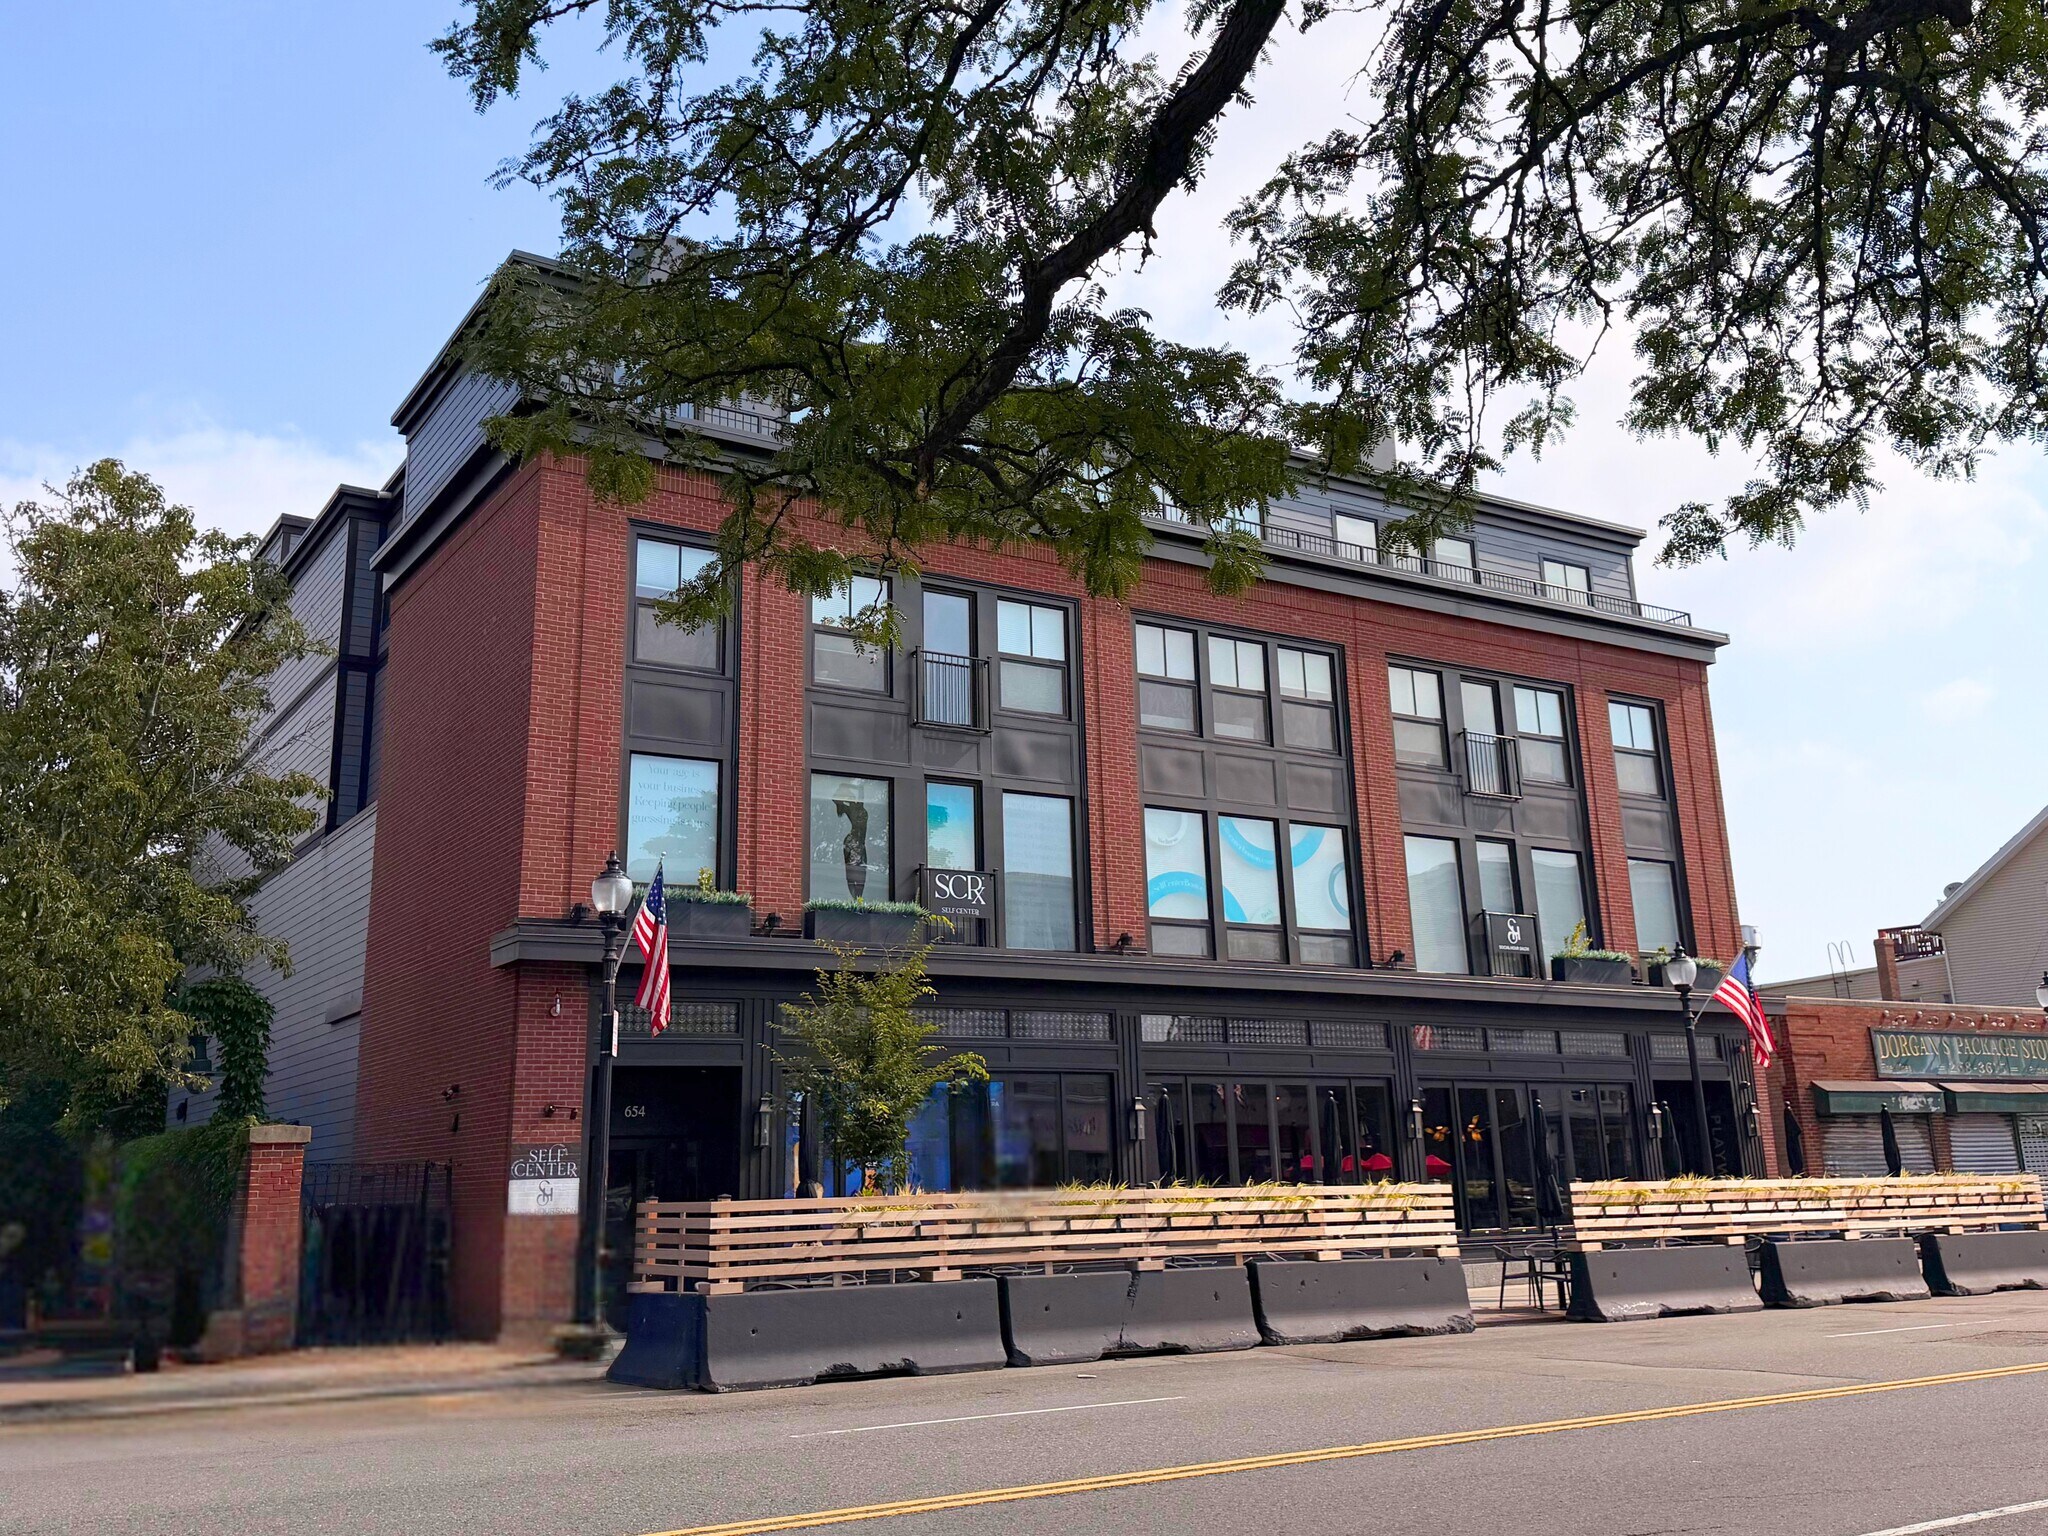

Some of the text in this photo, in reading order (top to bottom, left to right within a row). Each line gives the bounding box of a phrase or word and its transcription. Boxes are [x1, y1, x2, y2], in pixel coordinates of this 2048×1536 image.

[648, 763, 700, 780] Your age is
[638, 782, 659, 792] your
[635, 796, 709, 813] Keeping people
[1876, 1033, 1950, 1059] DORGANS
[1954, 1036, 2019, 1058] PACKAGE
[624, 1105, 646, 1118] 654
[528, 1147, 568, 1163] SELF
